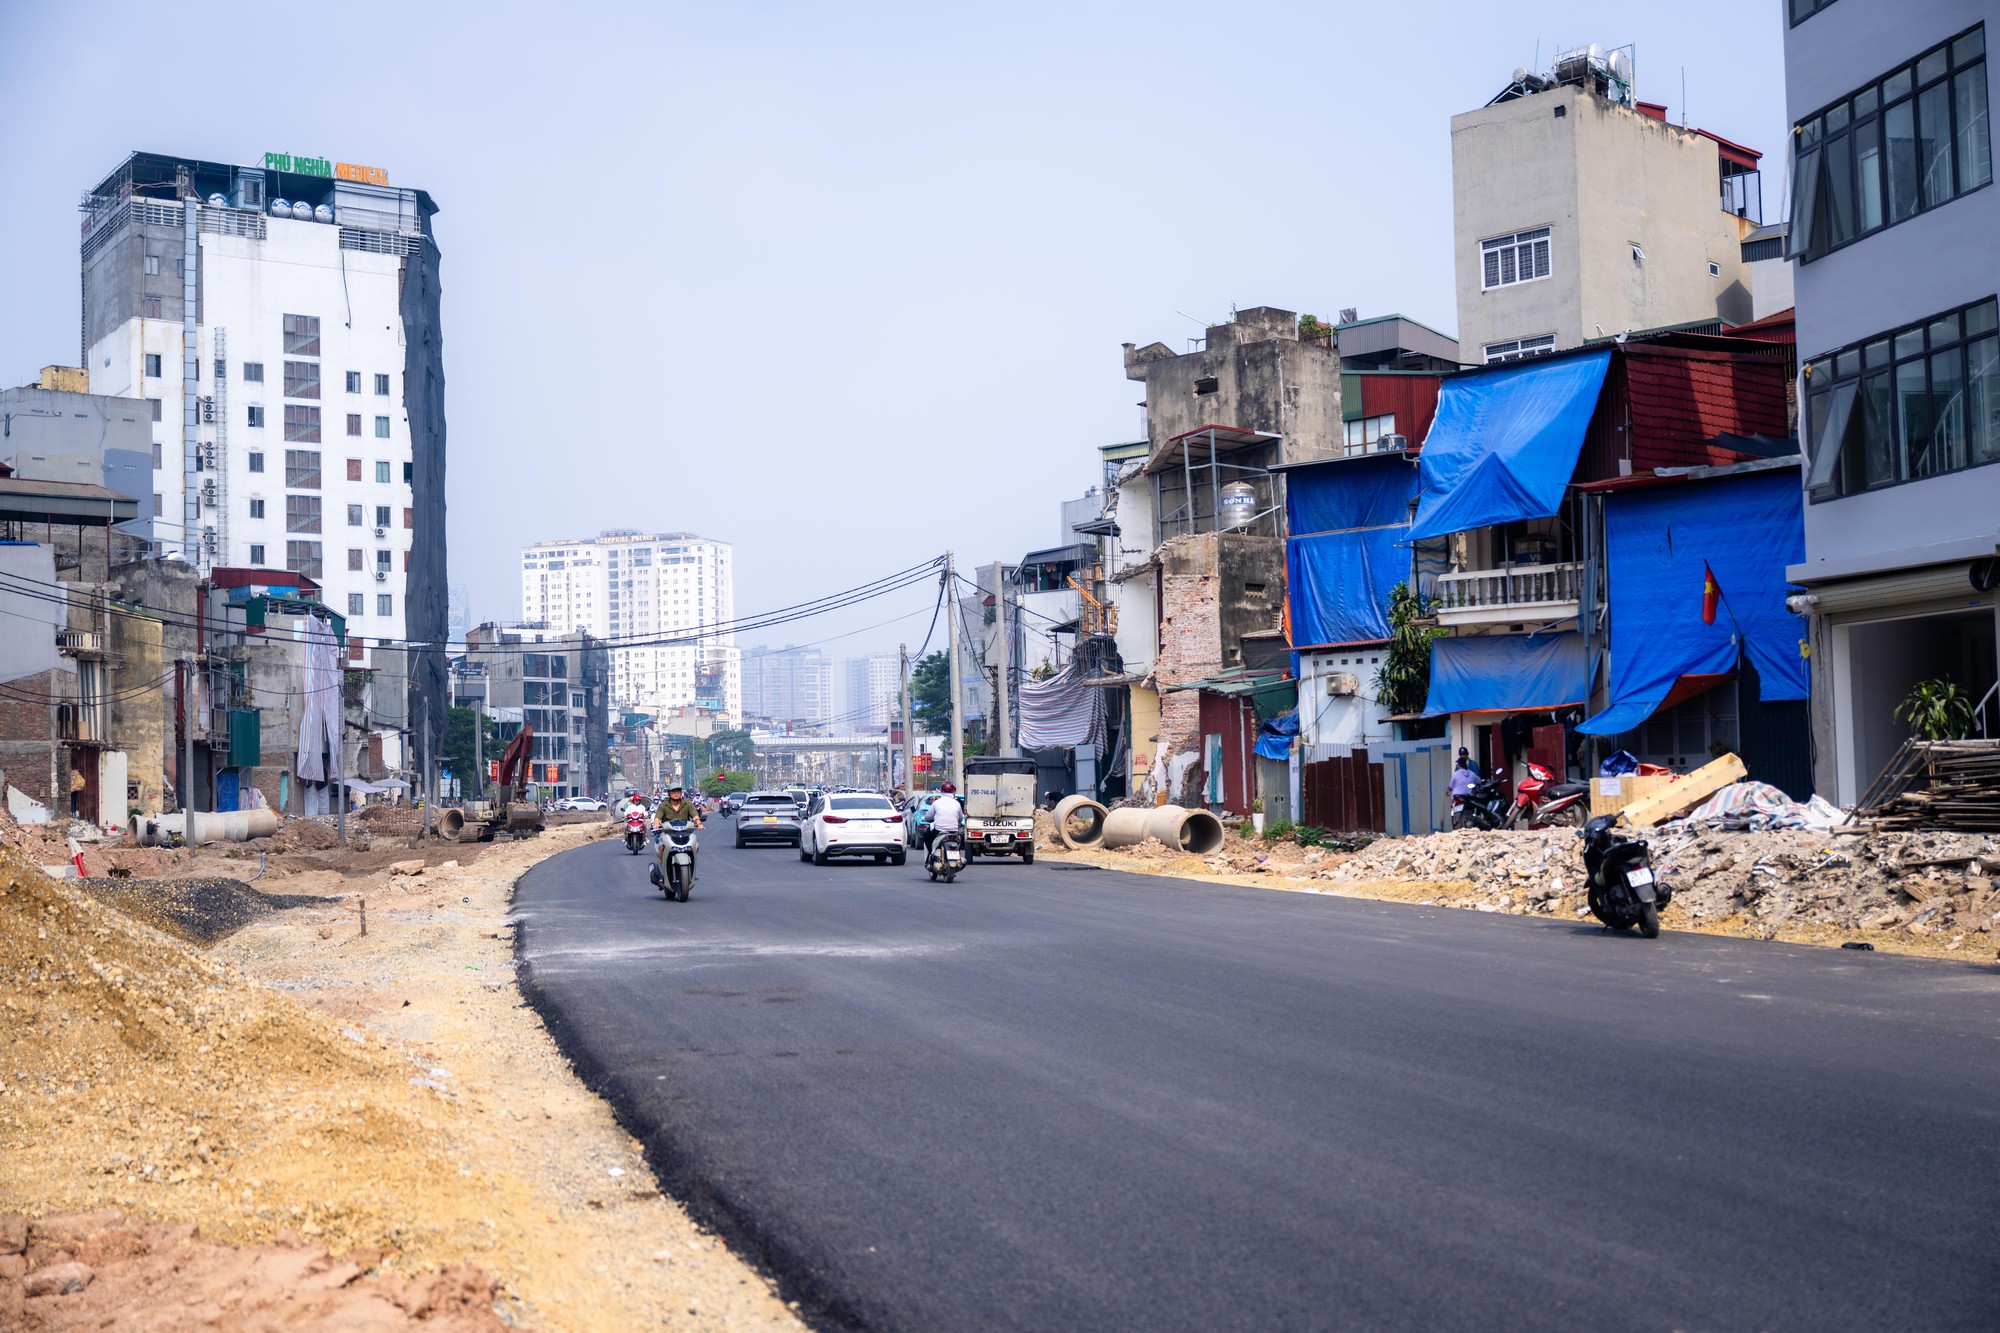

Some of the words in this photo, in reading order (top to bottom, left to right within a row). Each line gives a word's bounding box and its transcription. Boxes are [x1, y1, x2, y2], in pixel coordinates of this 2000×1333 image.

[265, 151, 291, 172] PHÚ
[294, 156, 332, 178] NGHĨA
[336, 162, 389, 186] MEDICAL
